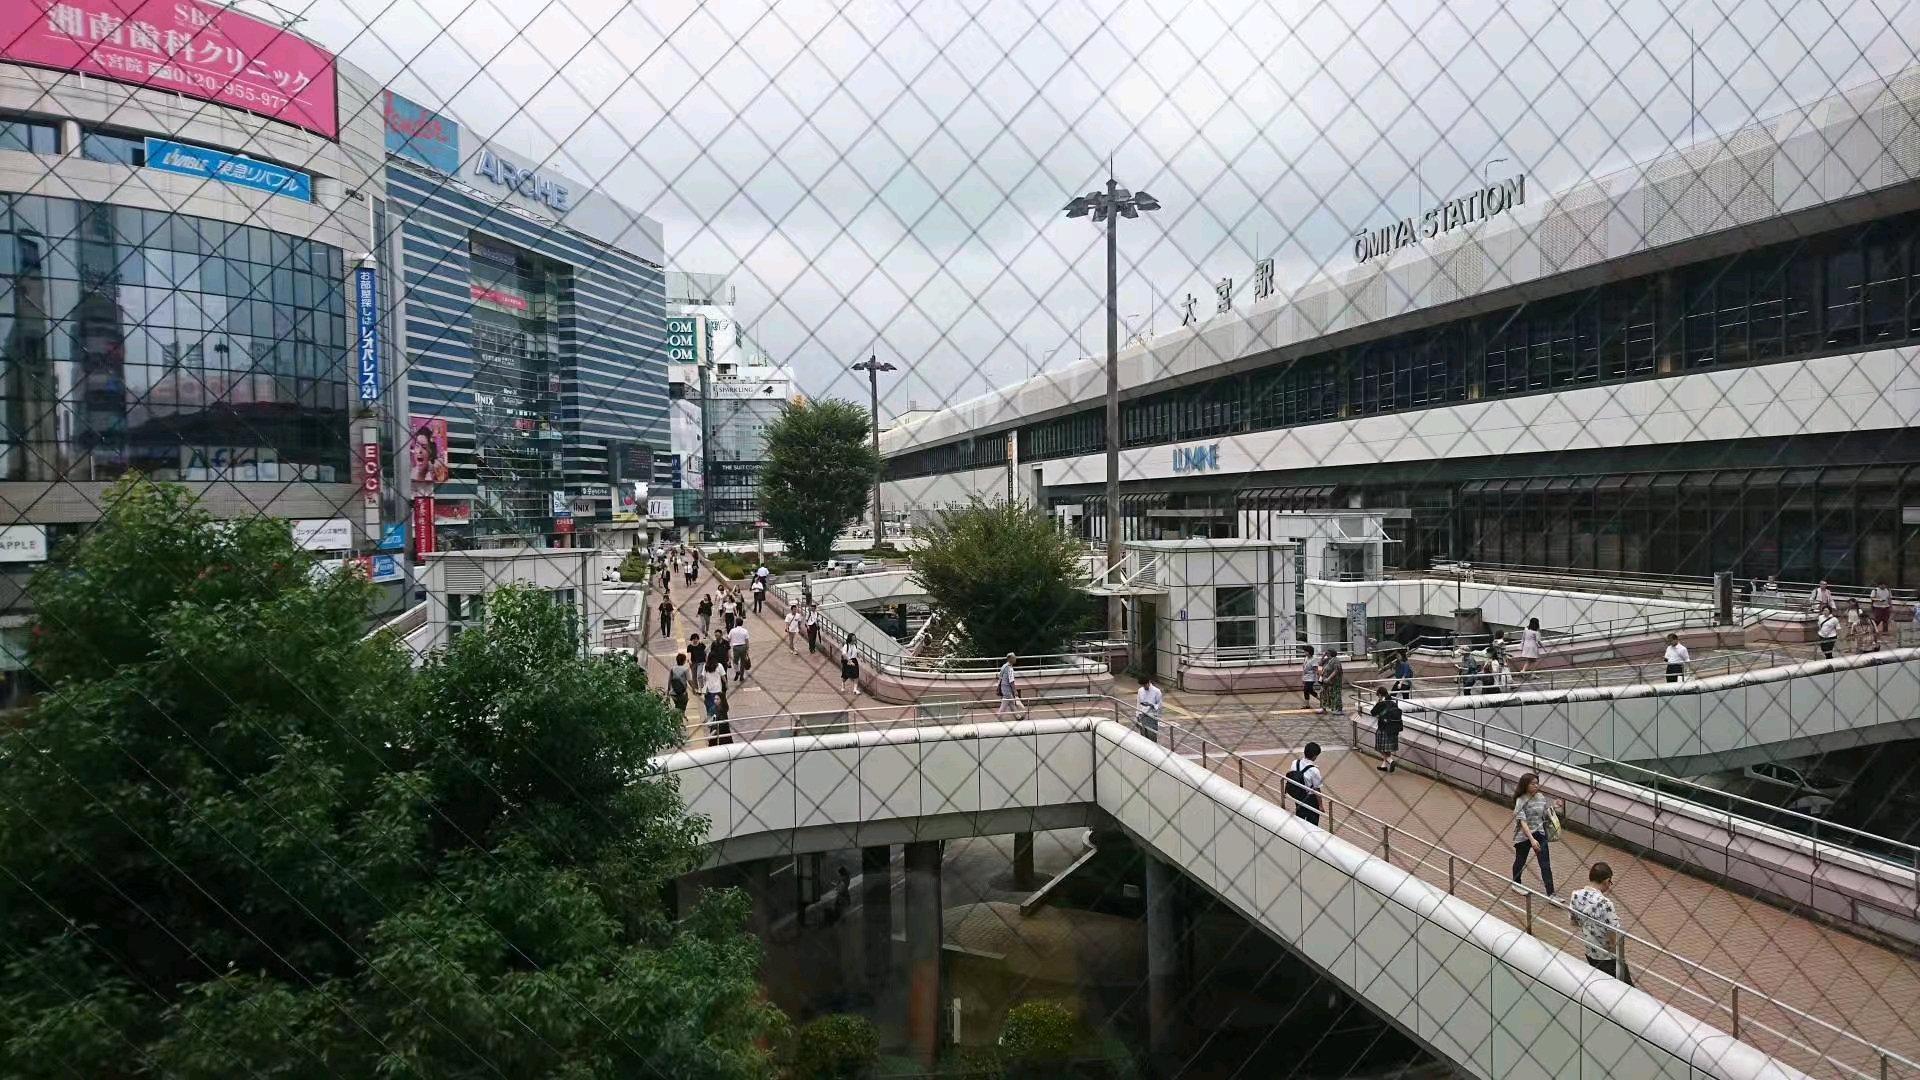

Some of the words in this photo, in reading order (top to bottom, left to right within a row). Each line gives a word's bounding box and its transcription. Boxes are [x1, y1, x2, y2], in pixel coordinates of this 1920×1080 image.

[173, 2, 223, 28] SBC
[47, 2, 312, 94] 湘南歯科クリニック
[87, 50, 144, 74] 大宮院
[172, 69, 291, 112] 0120-955-977
[215, 159, 299, 192] 東急リバブル
[475, 150, 570, 213] ARCHE
[1423, 173, 1526, 239] STATION
[1181, 257, 1275, 328] 大宮駅
[667, 321, 693, 333] OM
[667, 335, 694, 346] OM
[668, 348, 695, 360] OM
[1172, 444, 1220, 472] LUMINE
